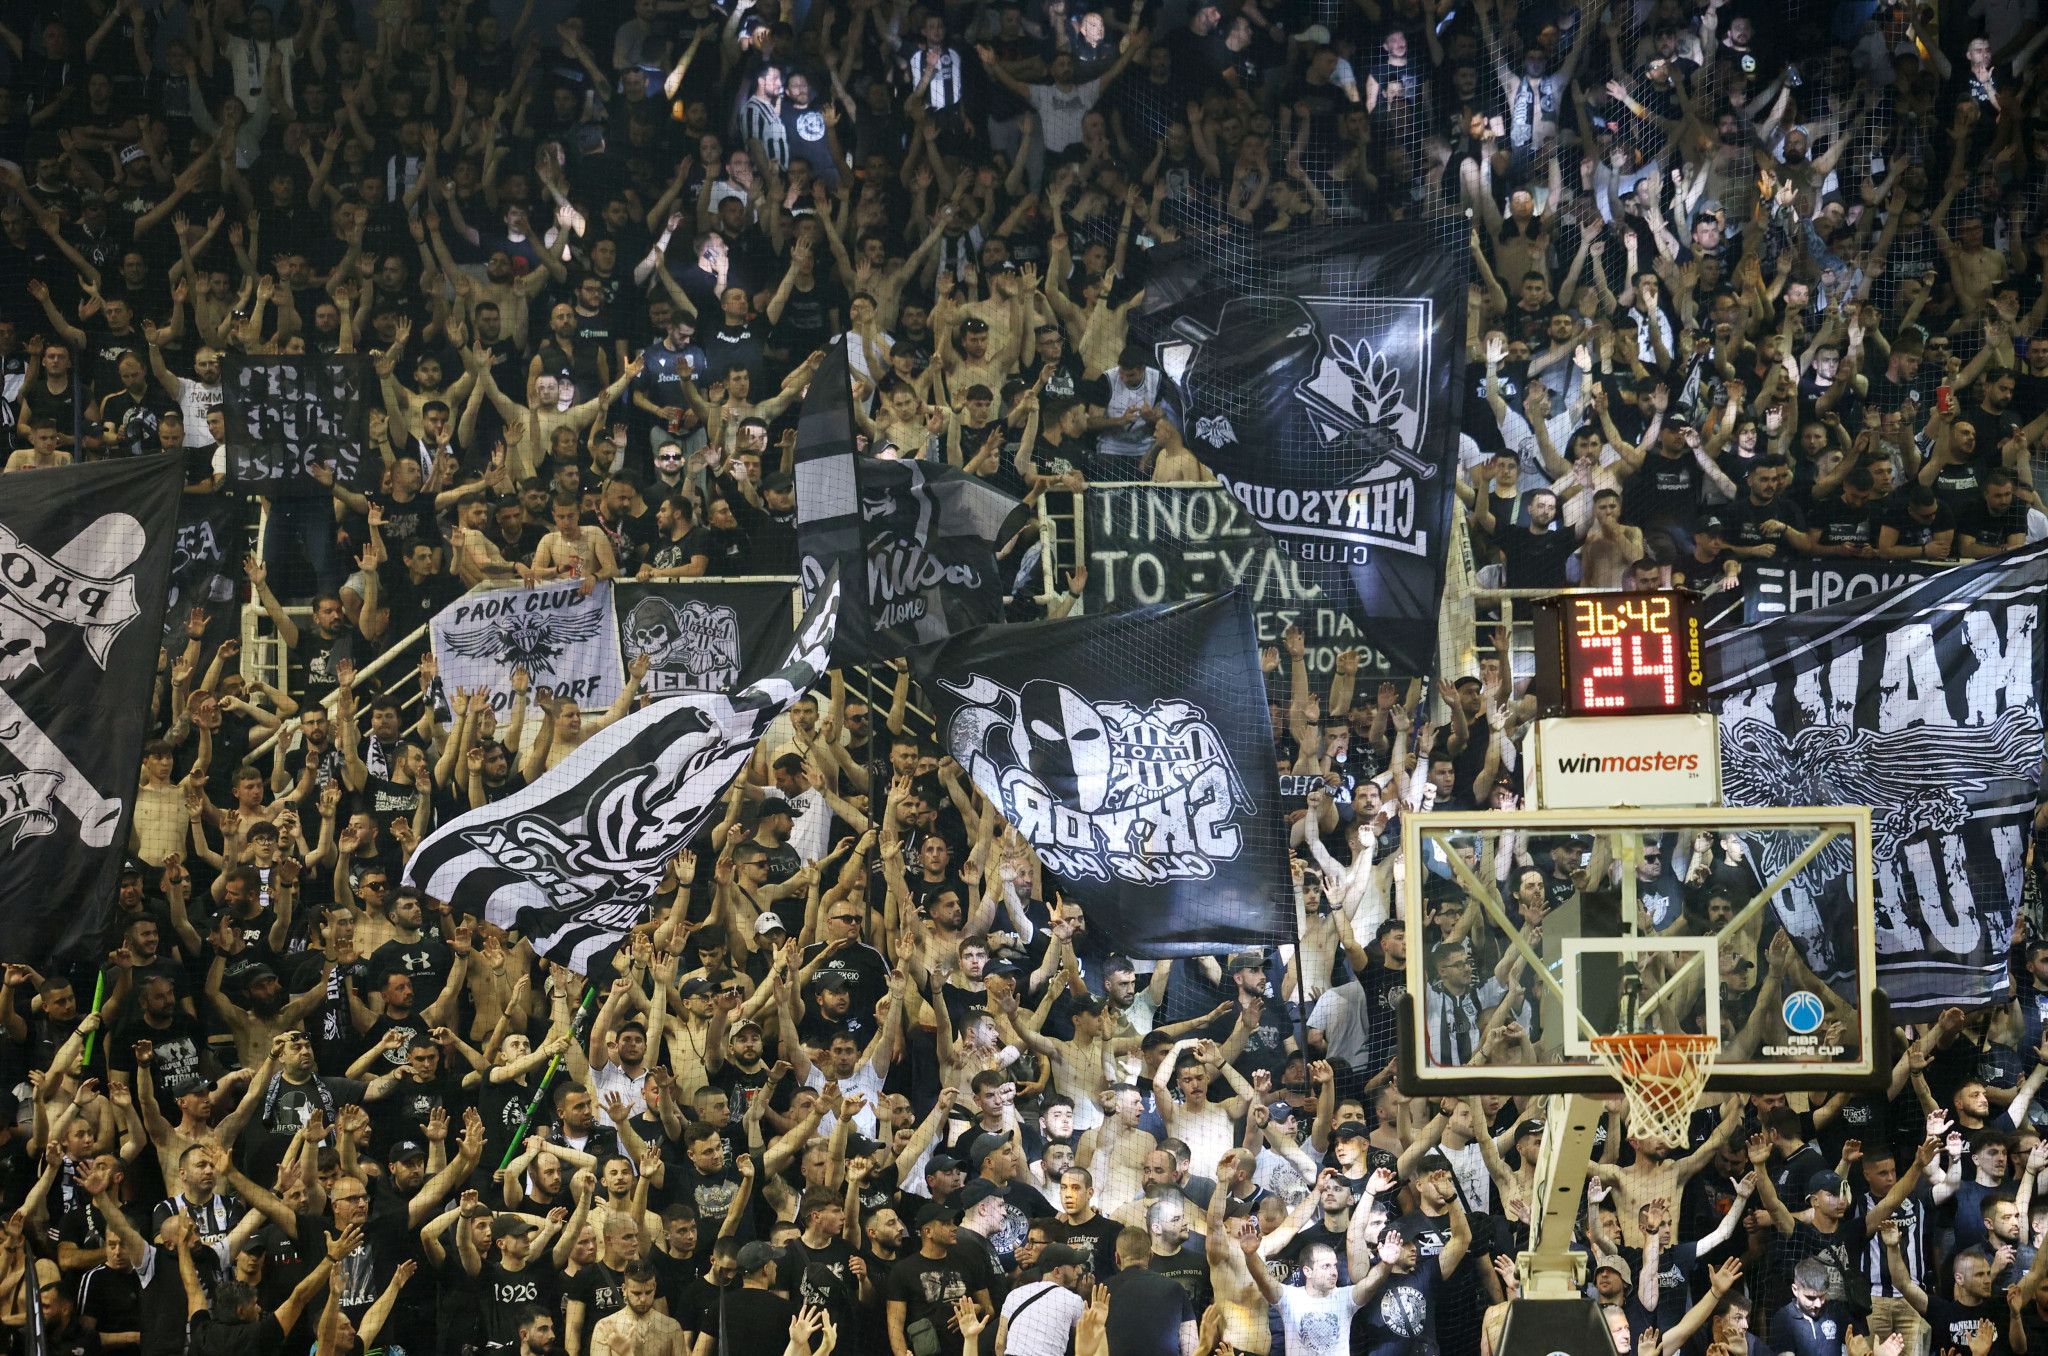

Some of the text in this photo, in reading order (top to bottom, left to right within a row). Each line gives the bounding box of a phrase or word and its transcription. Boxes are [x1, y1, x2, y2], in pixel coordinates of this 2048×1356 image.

[455, 594, 518, 626] PAOK
[1575, 597, 1671, 637] 36:42
[689, 622, 725, 641] ΠΑΟΚ
[1687, 617, 1703, 686] Quince
[1582, 634, 1675, 708] 24
[1558, 751, 1698, 773] winmasters
[1762, 1045, 1845, 1056] EUROPE CUP
[1788, 1035, 1818, 1046] FIBA
[494, 1281, 538, 1303] 1926
